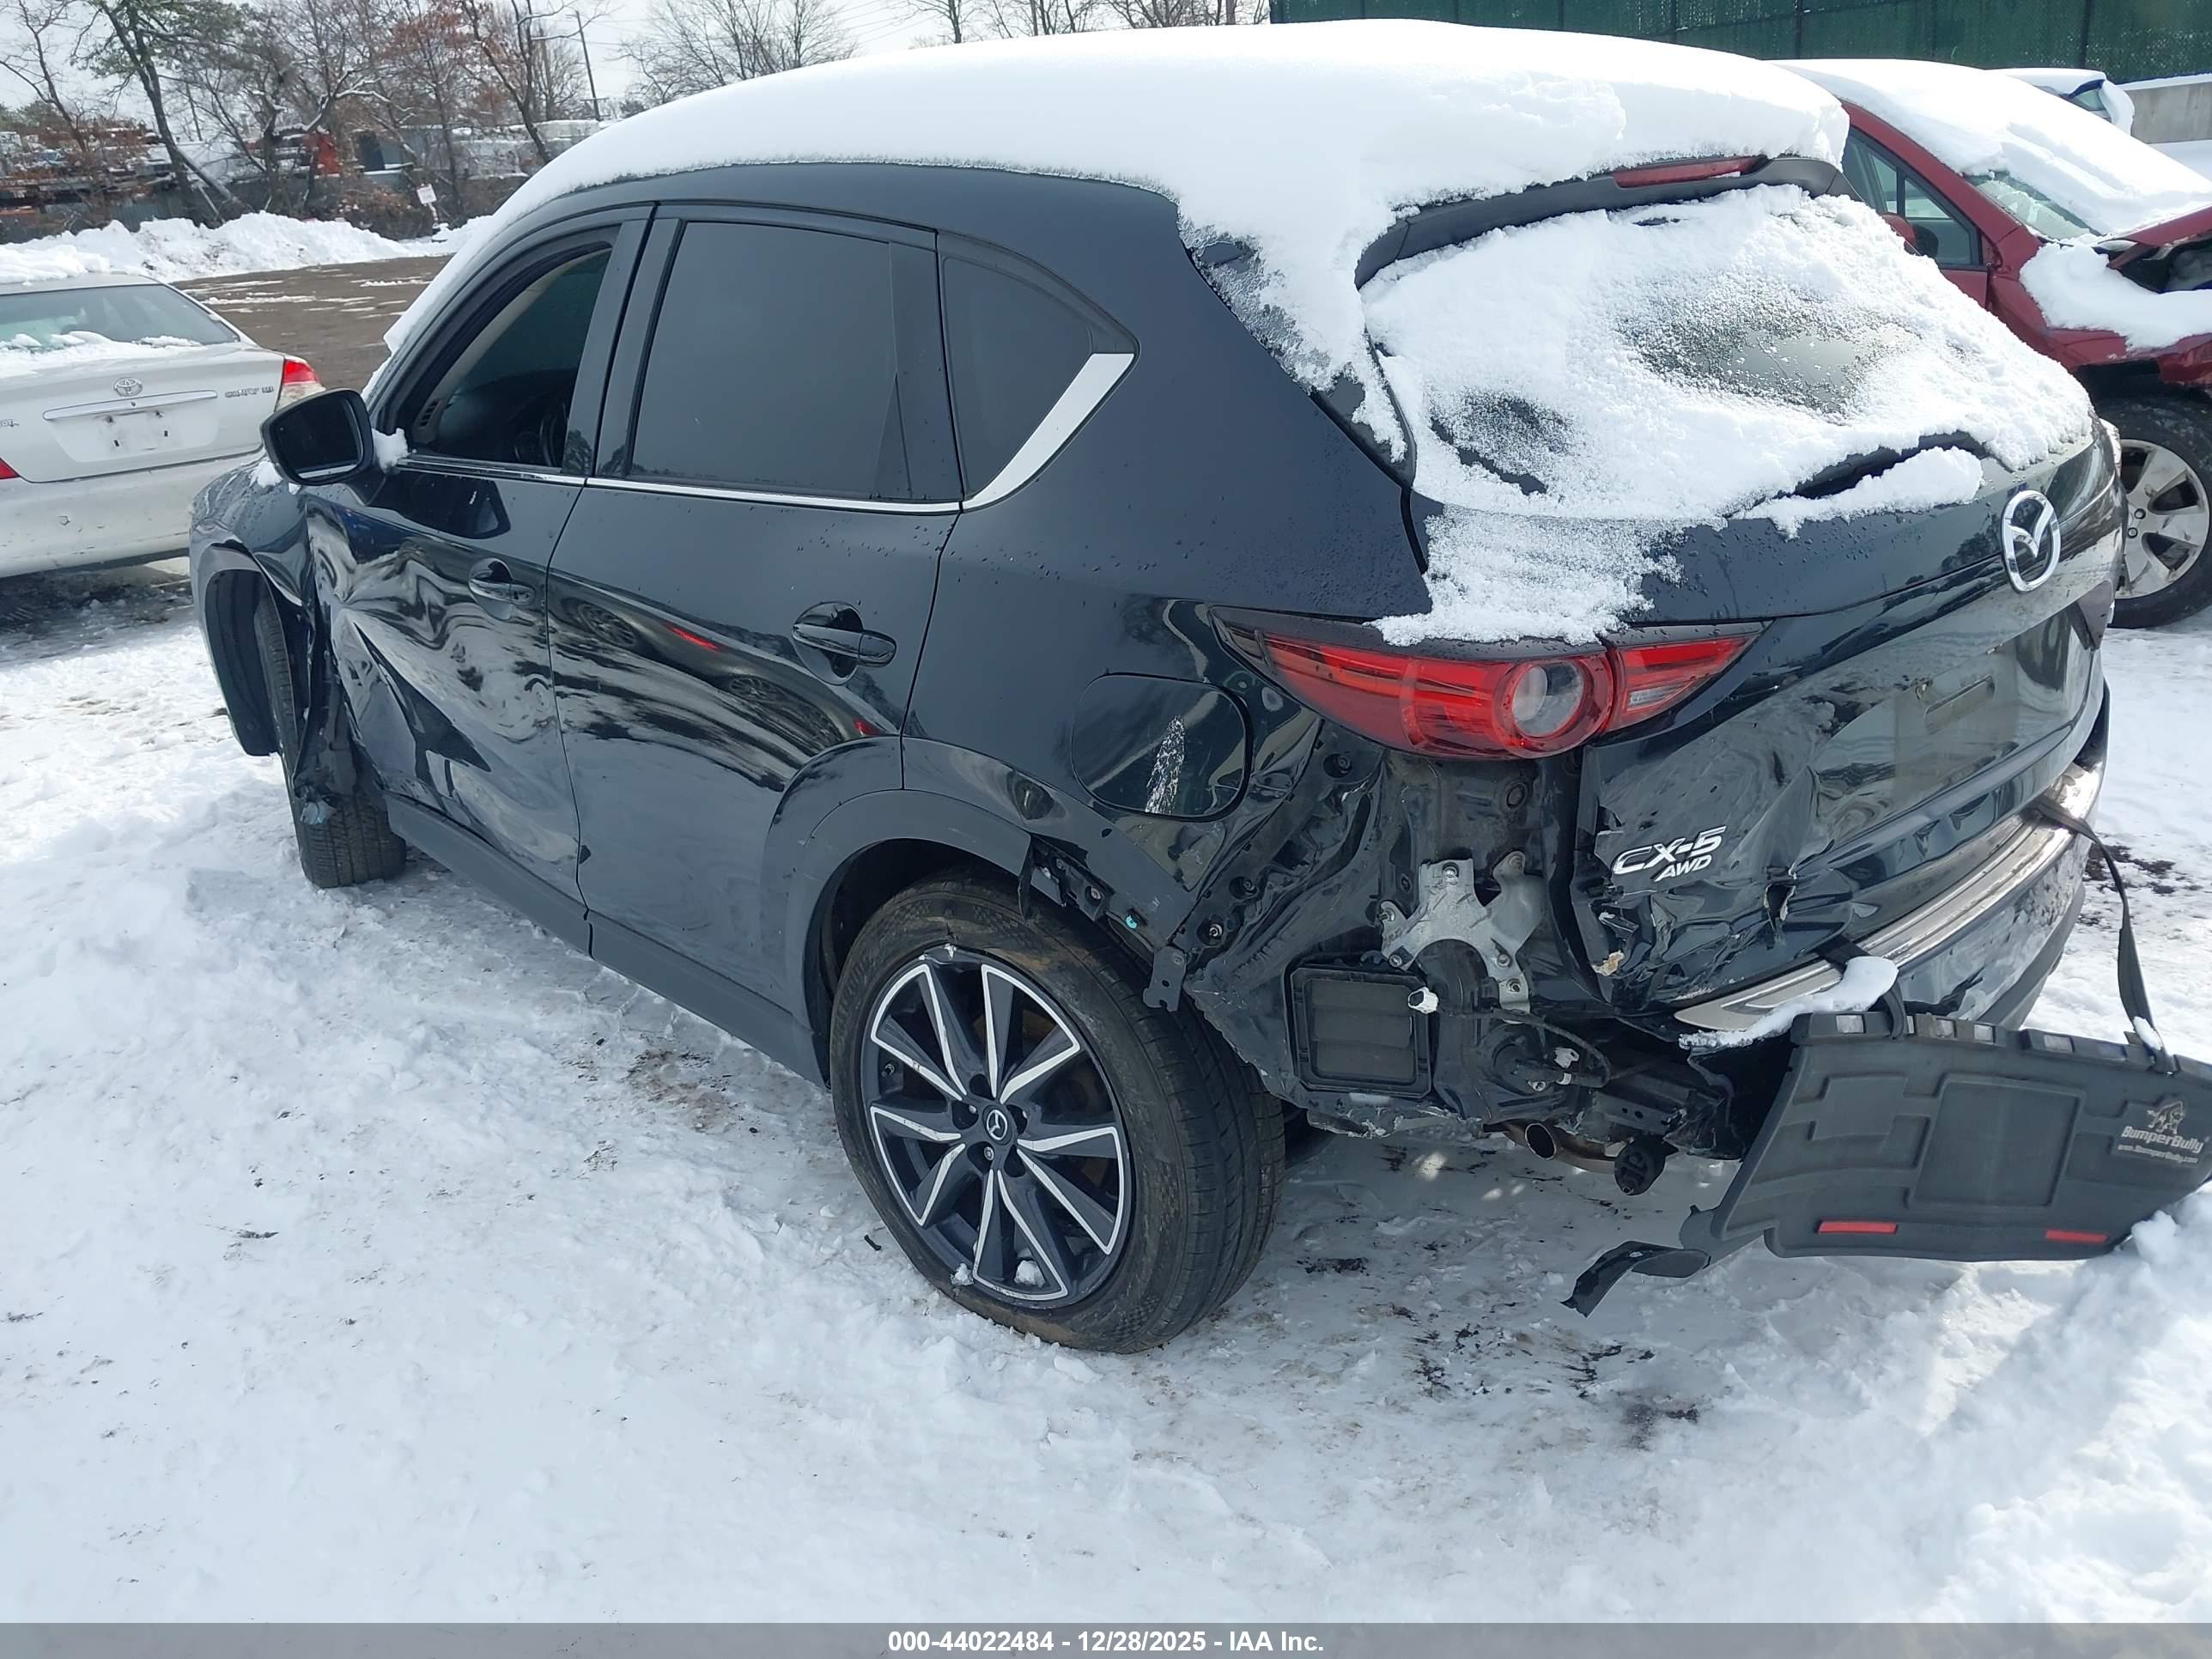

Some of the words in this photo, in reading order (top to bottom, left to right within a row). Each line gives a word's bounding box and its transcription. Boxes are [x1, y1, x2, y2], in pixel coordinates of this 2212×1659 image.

[1613, 825, 1728, 875] CX-5
[1653, 854, 1712, 883] AWD
[2120, 1126, 2204, 1154] BumperBully
